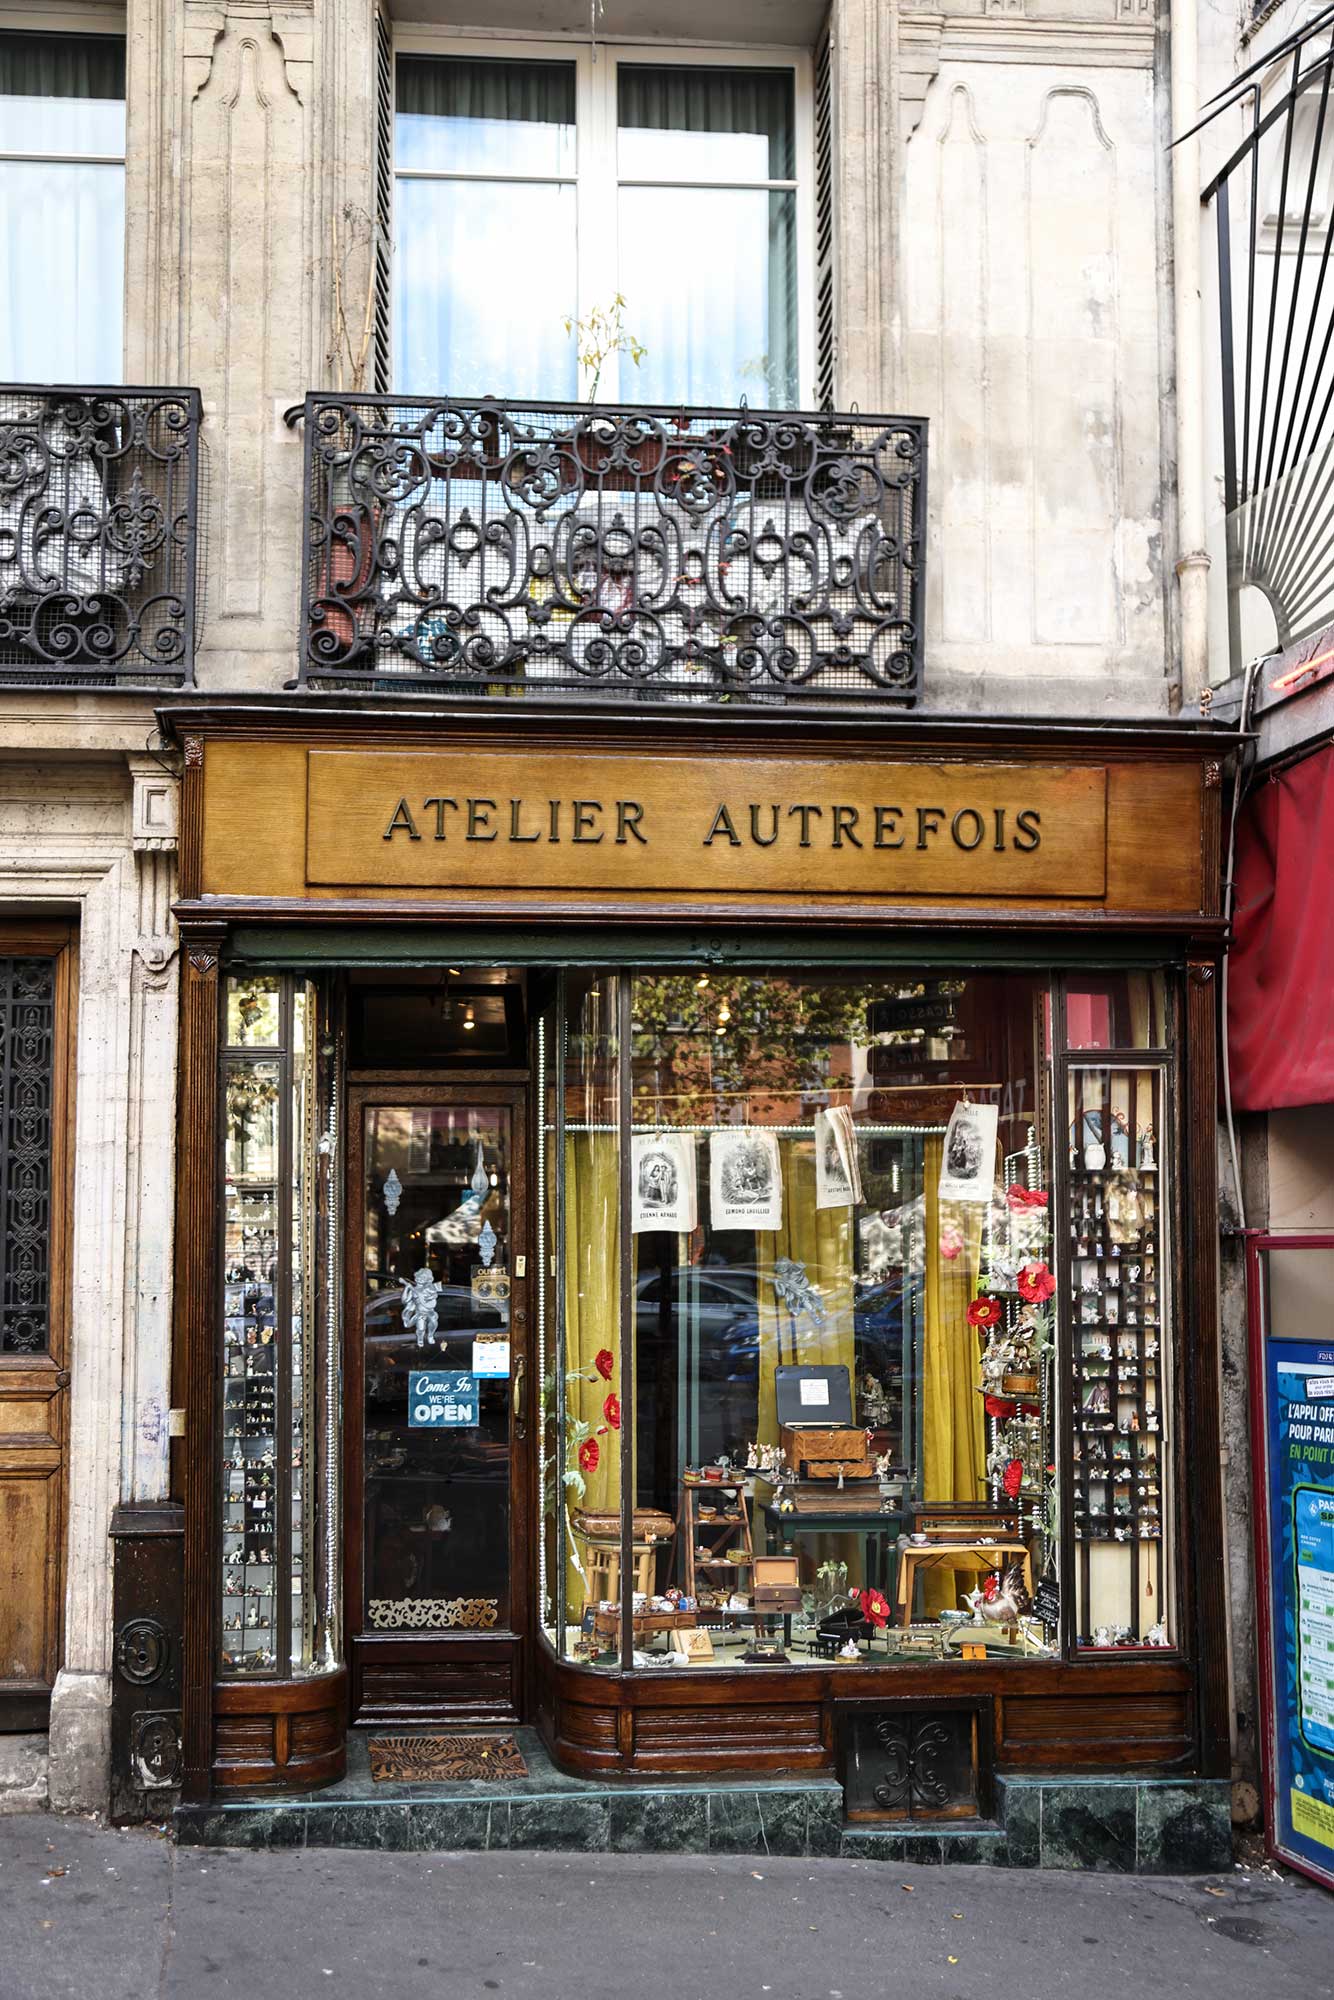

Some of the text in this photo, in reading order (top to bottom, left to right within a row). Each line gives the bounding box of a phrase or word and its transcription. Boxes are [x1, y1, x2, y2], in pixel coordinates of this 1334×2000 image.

[382, 797, 1042, 851] ATELIER AUTREFOIS
[416, 1376, 472, 1395] Come In
[429, 1395, 455, 1404] WE'RE
[414, 1404, 473, 1422] OPEN
[1288, 1403, 1318, 1421] L'APPLI
[1289, 1423, 1312, 1441] POUR
[1289, 1443, 1301, 1459] EN
[1302, 1445, 1329, 1463] POINT
